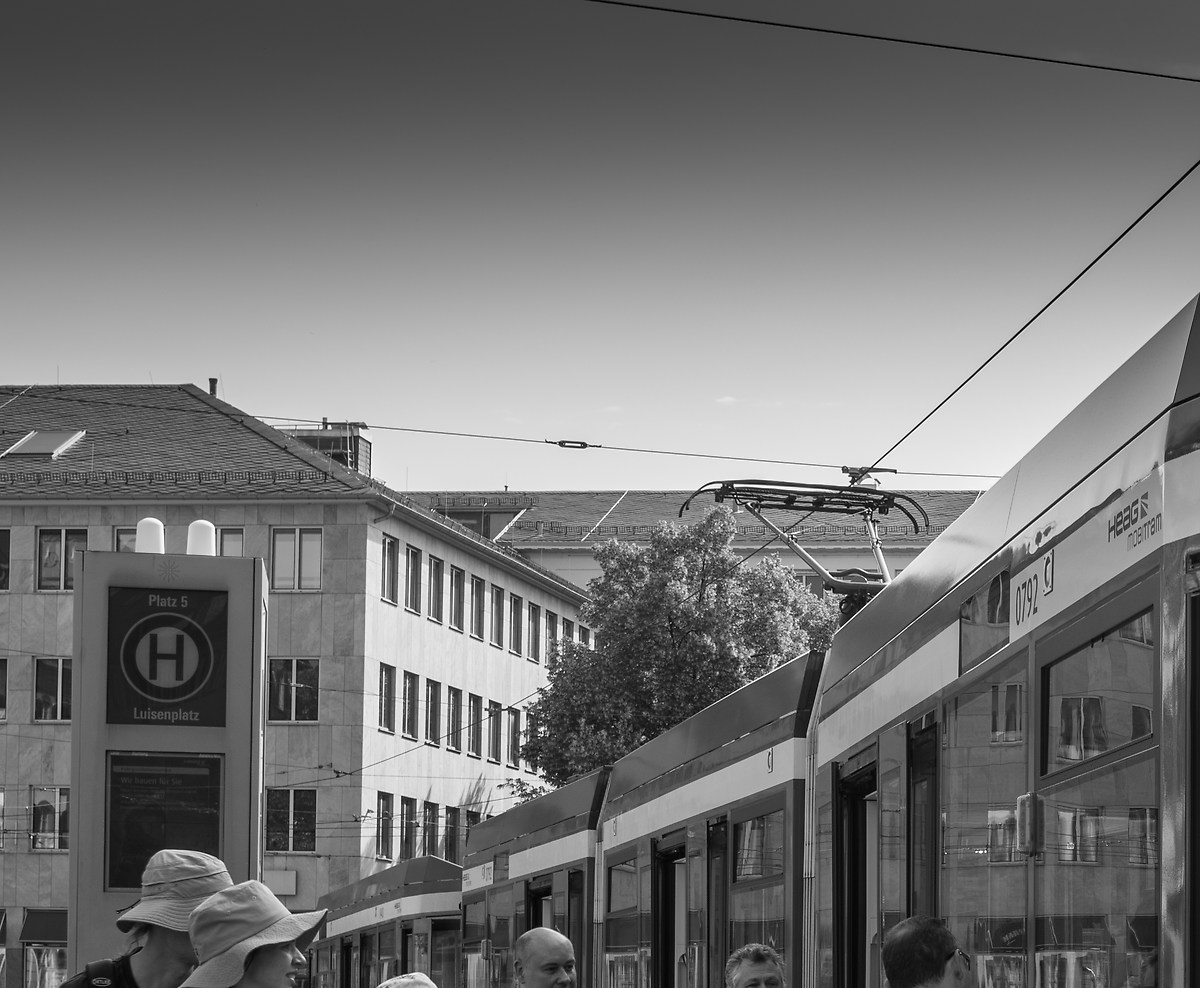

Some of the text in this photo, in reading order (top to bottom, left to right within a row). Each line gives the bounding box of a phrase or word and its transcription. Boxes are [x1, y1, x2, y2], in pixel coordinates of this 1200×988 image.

[148, 594, 188, 608] Platz 5
[1014, 573, 1039, 627] 0792
[148, 633, 185, 682] H
[133, 707, 200, 723] Luisenplatz
